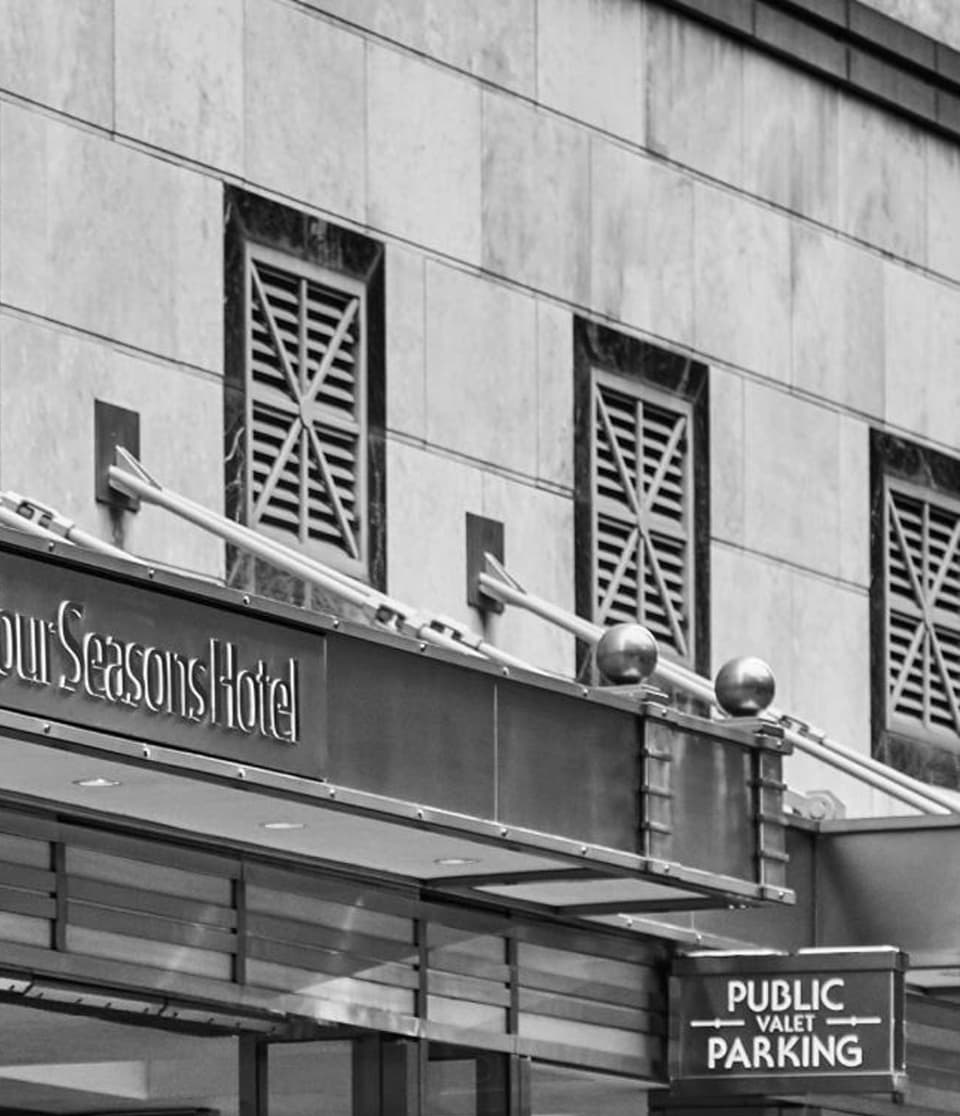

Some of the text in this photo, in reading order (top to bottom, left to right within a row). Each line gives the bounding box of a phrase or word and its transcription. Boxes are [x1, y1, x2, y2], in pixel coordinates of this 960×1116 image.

[57, 599, 209, 722] Seasons
[208, 637, 299, 743] Hotel
[727, 978, 845, 1012] PUBLIC
[756, 1014, 816, 1033] VALET
[707, 1034, 864, 1070] PARKING
